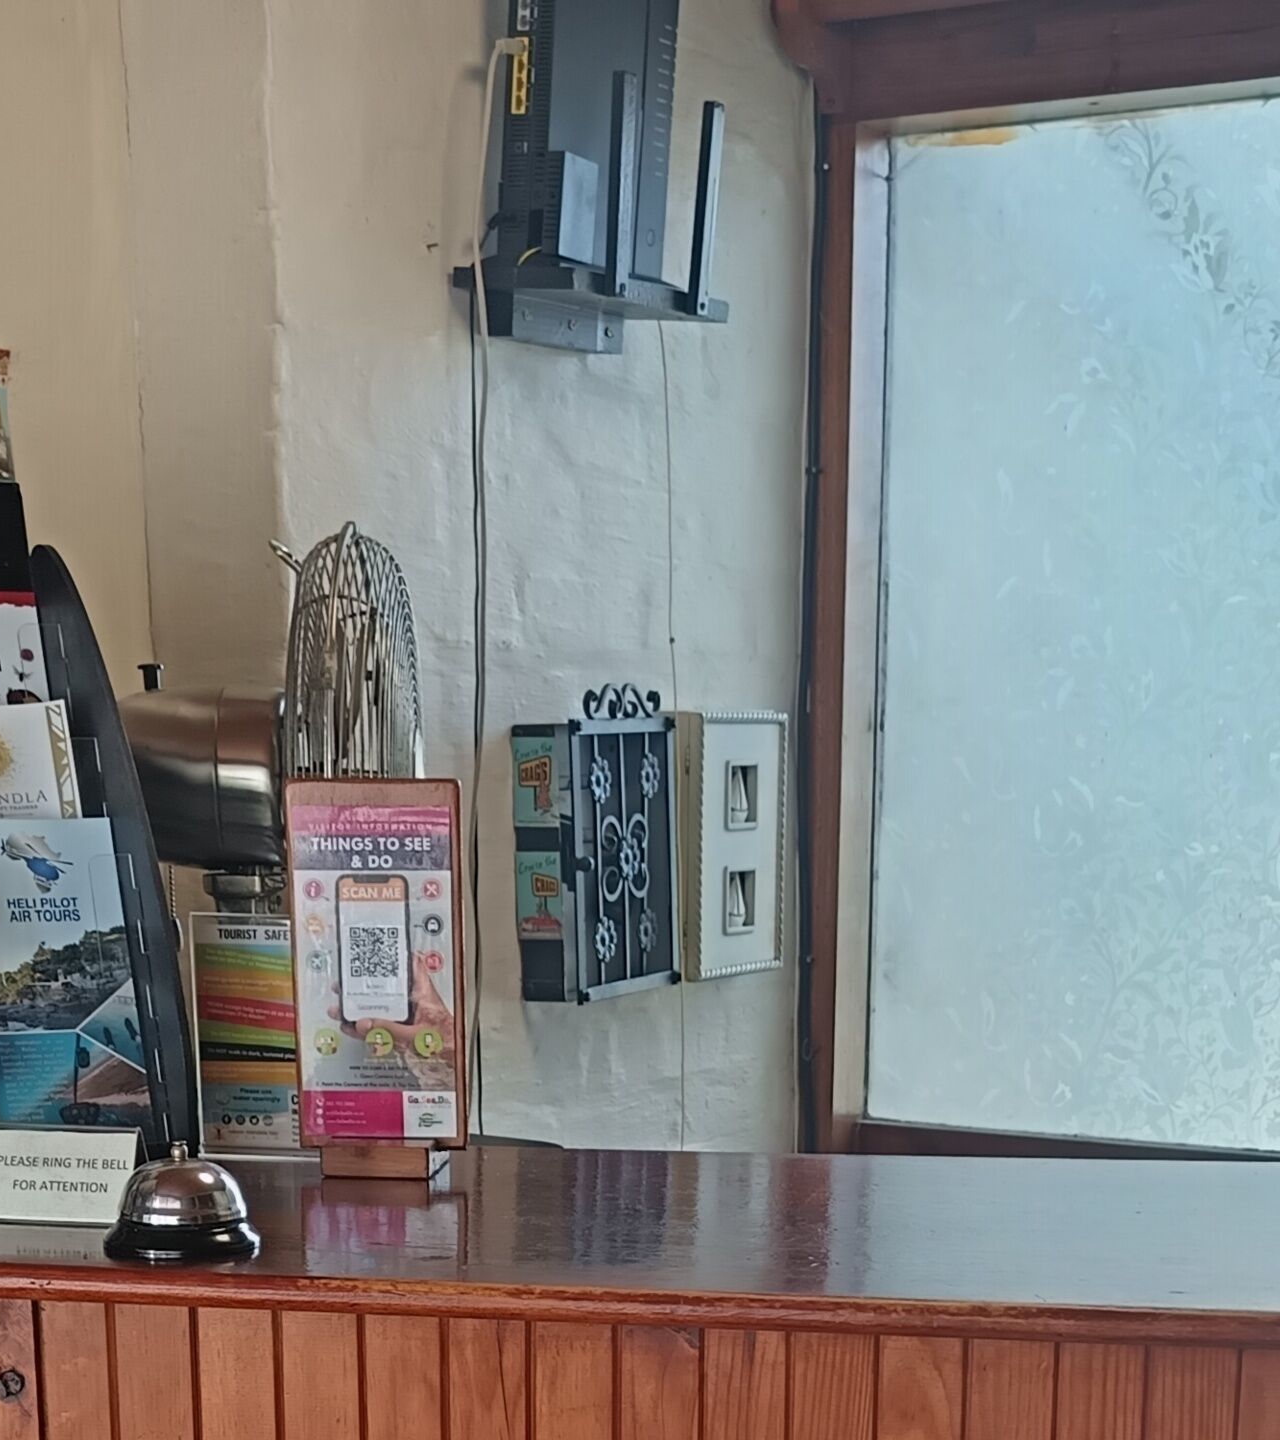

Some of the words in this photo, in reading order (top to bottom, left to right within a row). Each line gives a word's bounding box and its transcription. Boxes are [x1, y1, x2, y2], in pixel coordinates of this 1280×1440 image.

[356, 822, 433, 831] INFORMATION
[311, 836, 373, 851] THINGS
[377, 836, 400, 851] TO
[404, 836, 431, 851] SEE
[350, 855, 363, 869] &
[368, 855, 393, 868] DO
[342, 887, 379, 899] SCAN
[382, 887, 401, 898] ME
[6, 898, 37, 910] HELI
[40, 897, 79, 909] PILOT
[9, 909, 33, 923] AIR
[34, 908, 81, 922] TOURS
[217, 928, 257, 940] TOURIST
[42, 1155, 72, 1169] RING
[75, 1156, 98, 1170] THE
[102, 1157, 129, 1172] BELL
[12, 1178, 36, 1192] FOR
[38, 1179, 109, 1194] ATTENTION
